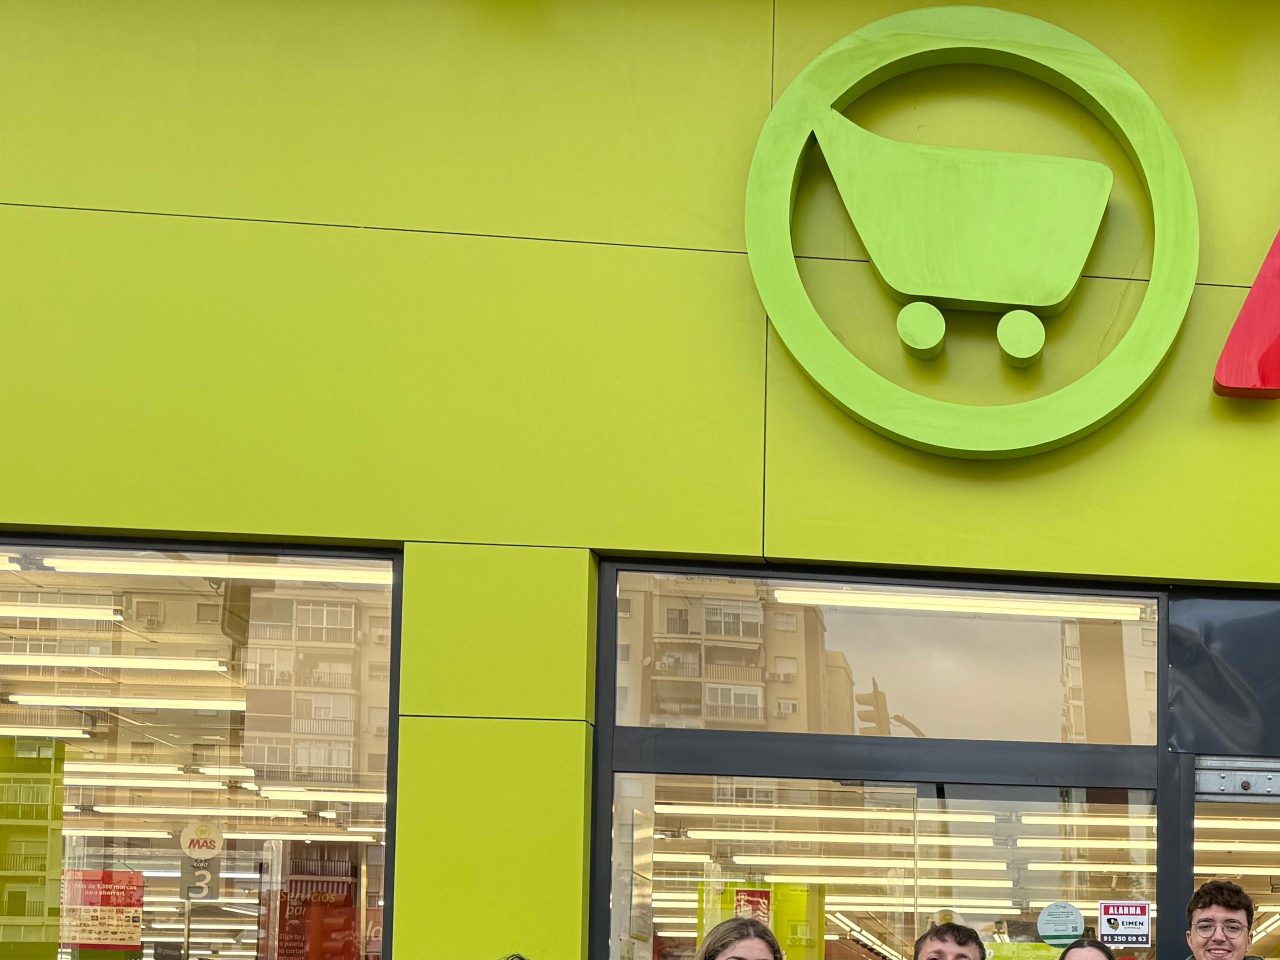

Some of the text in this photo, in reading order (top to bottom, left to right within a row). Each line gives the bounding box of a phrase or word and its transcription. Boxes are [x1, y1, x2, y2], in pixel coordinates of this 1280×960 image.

[187, 838, 217, 850] MAS
[188, 869, 212, 898] 3
[279, 891, 336, 903] Servicios
[1108, 905, 1142, 915] ALARMA
